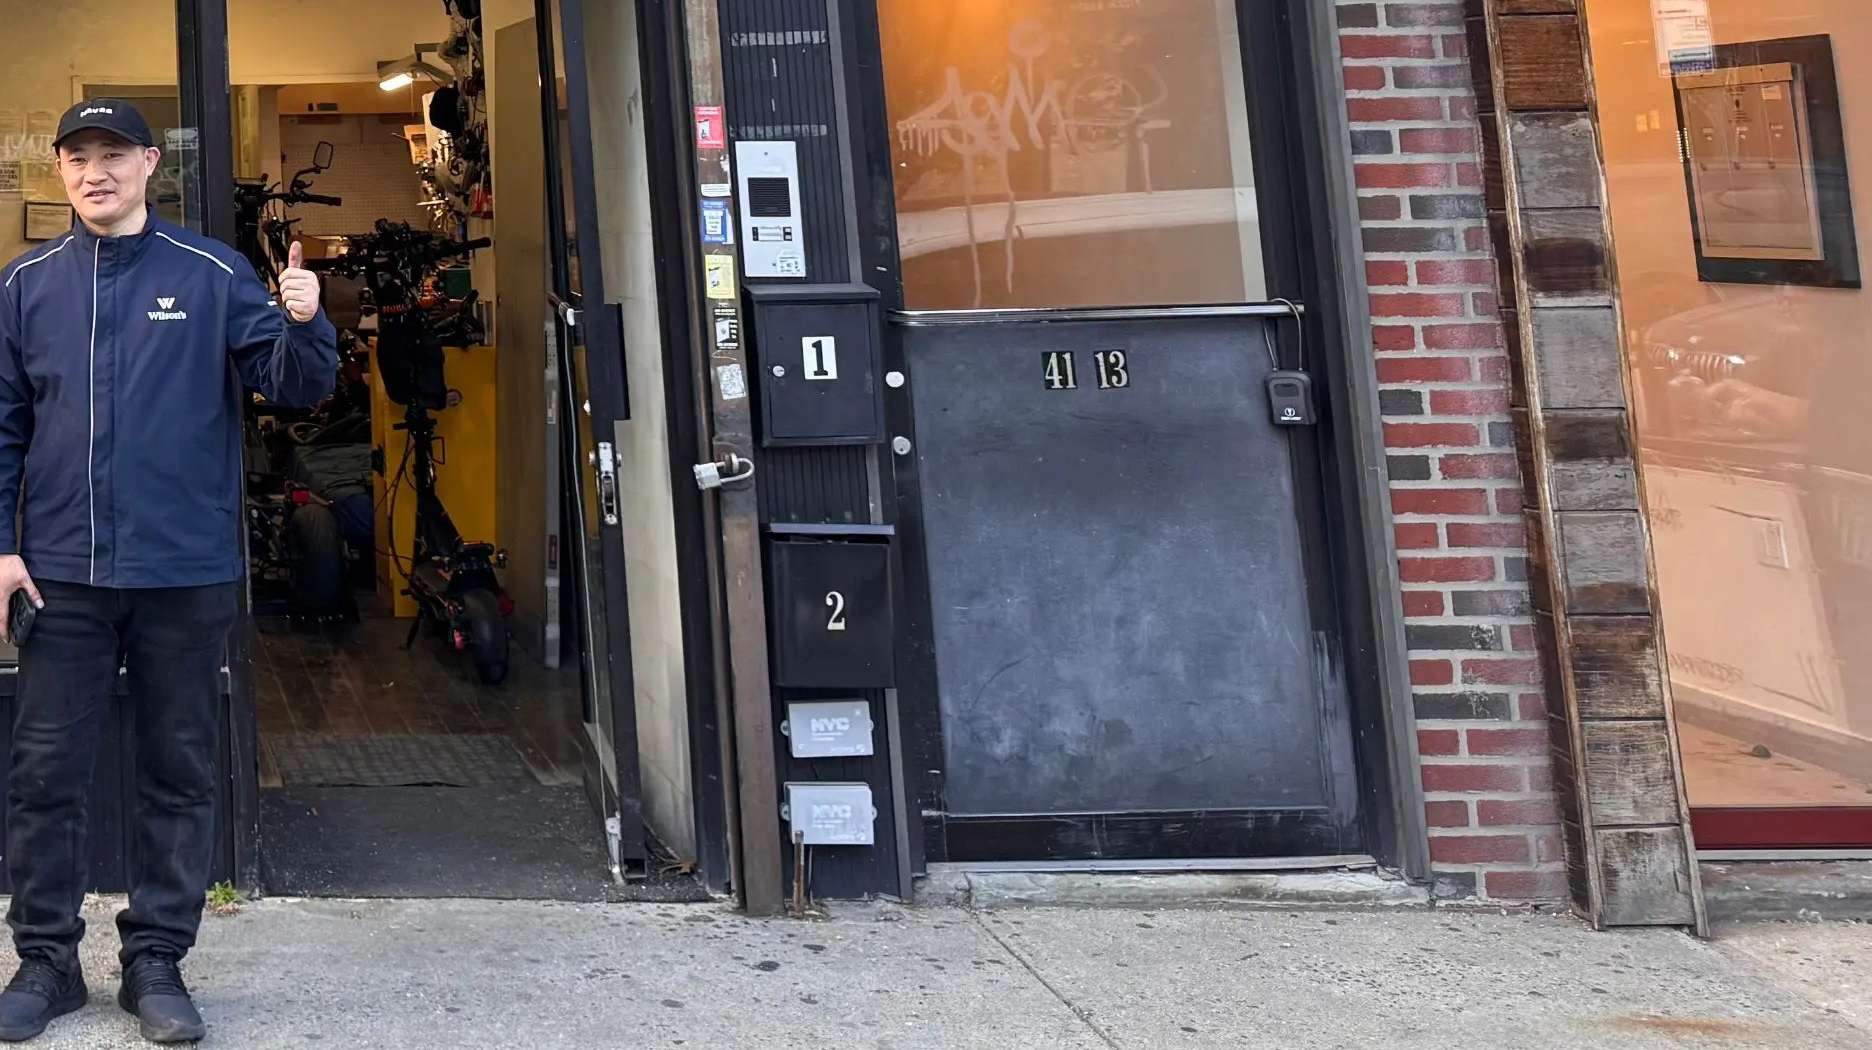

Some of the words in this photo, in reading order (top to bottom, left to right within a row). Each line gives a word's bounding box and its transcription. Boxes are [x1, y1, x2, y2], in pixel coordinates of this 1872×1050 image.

[147, 310, 187, 321] Wilson's
[811, 339, 829, 376] 1
[1044, 351, 1077, 389] 41
[1094, 350, 1128, 388] 13
[825, 590, 846, 631] 2
[810, 717, 851, 732] NYC
